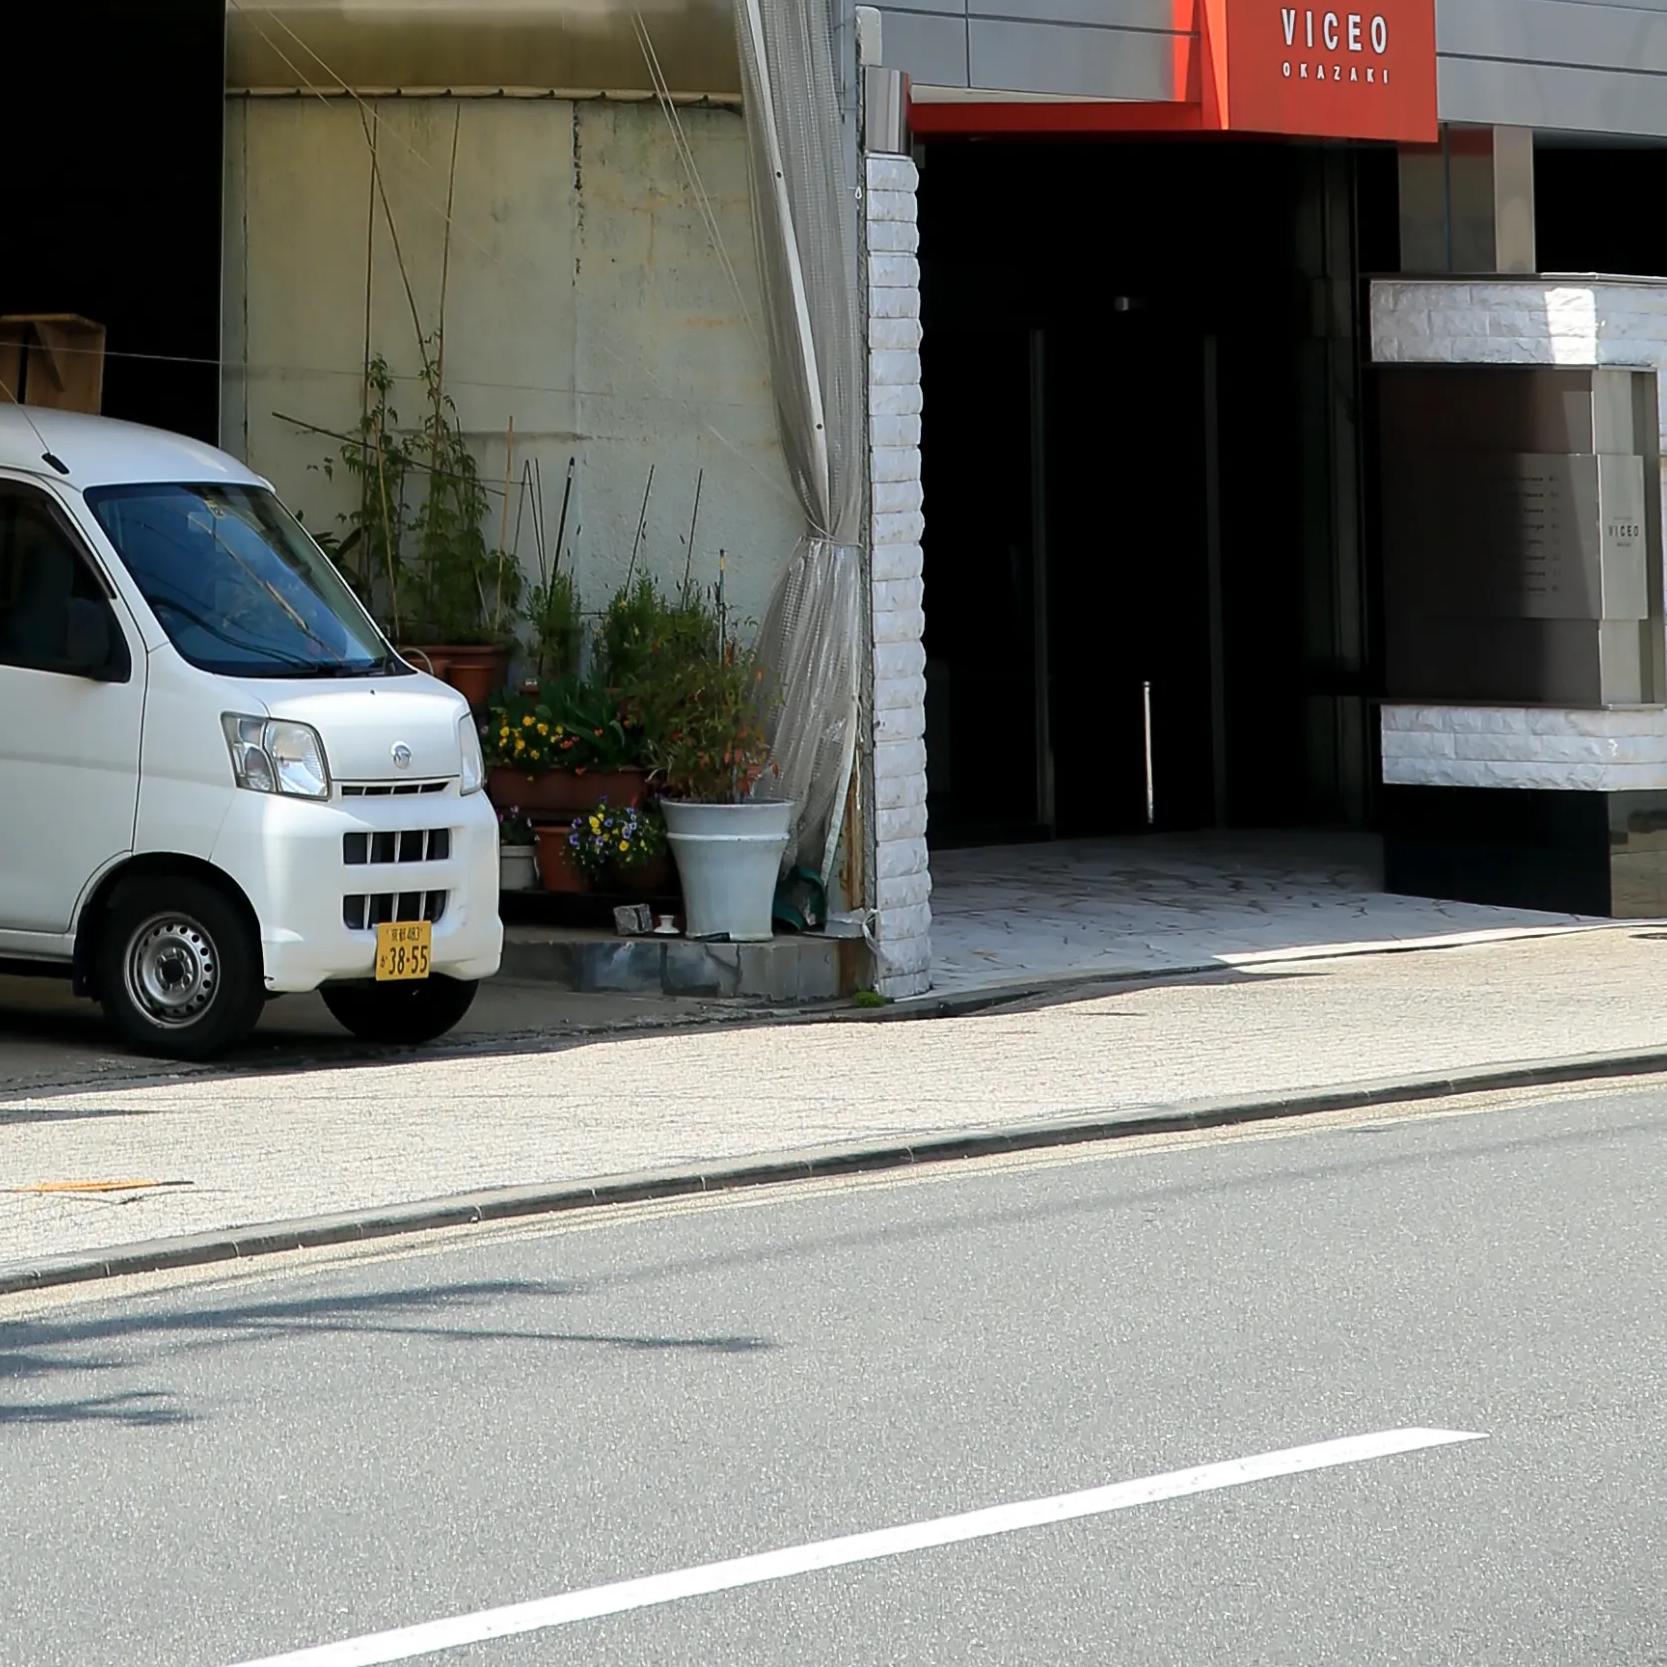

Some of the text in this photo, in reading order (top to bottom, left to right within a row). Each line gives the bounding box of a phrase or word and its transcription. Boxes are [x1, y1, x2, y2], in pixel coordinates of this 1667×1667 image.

[1281, 8, 1387, 54] VICEO
[1282, 62, 1388, 84] OKAZAKI
[1608, 525, 1640, 537] VICEO
